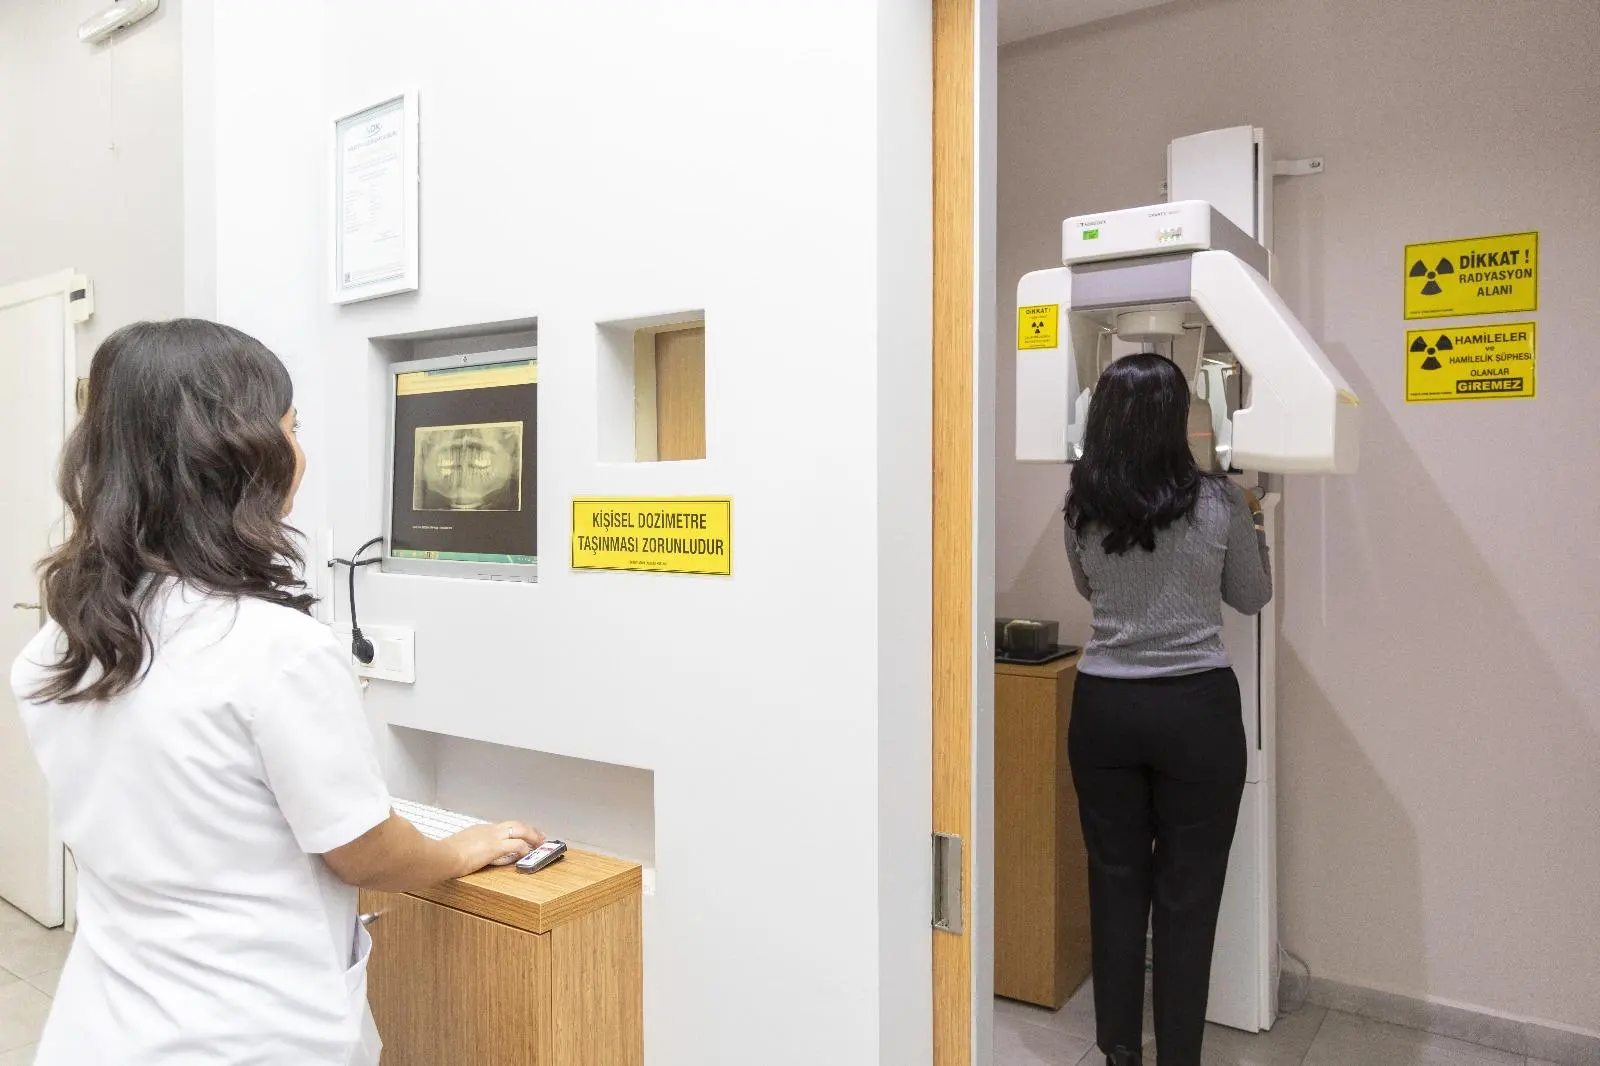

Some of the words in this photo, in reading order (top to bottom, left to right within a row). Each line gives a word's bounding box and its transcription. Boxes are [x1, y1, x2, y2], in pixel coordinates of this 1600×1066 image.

[1460, 249, 1519, 270] DİKKAT
[1459, 268, 1532, 284] RADYASYON
[1477, 285, 1513, 297] ALANI
[1455, 331, 1527, 345] HAMİLELER
[1470, 367, 1510, 377] OLANLAR
[592, 509, 635, 532] KİŞİSEL
[638, 509, 707, 530] DOZİMETRE
[577, 535, 639, 556] TAŞINMASI
[642, 537, 724, 556] ZORUNLUDUR
